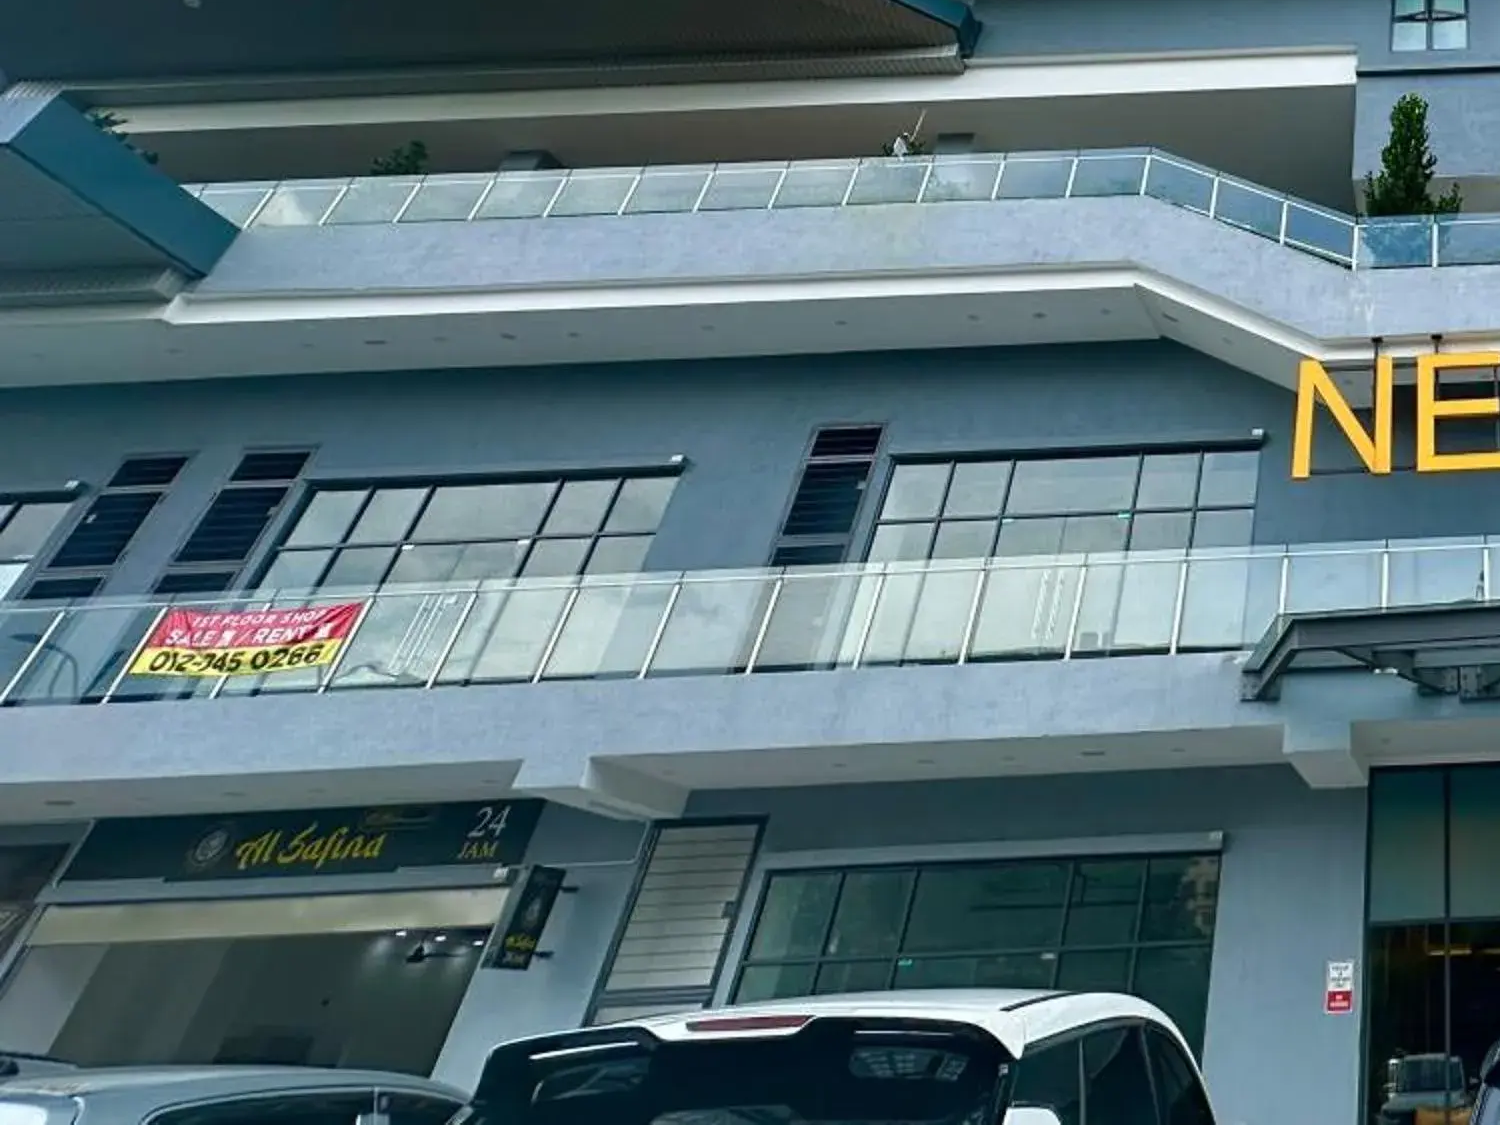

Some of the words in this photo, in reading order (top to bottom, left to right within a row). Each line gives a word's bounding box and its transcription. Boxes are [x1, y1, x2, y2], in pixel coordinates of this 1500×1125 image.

[165, 629, 218, 646] SALE
[252, 626, 308, 643] RENT
[467, 805, 510, 838] 24
[457, 841, 499, 860] JAM
